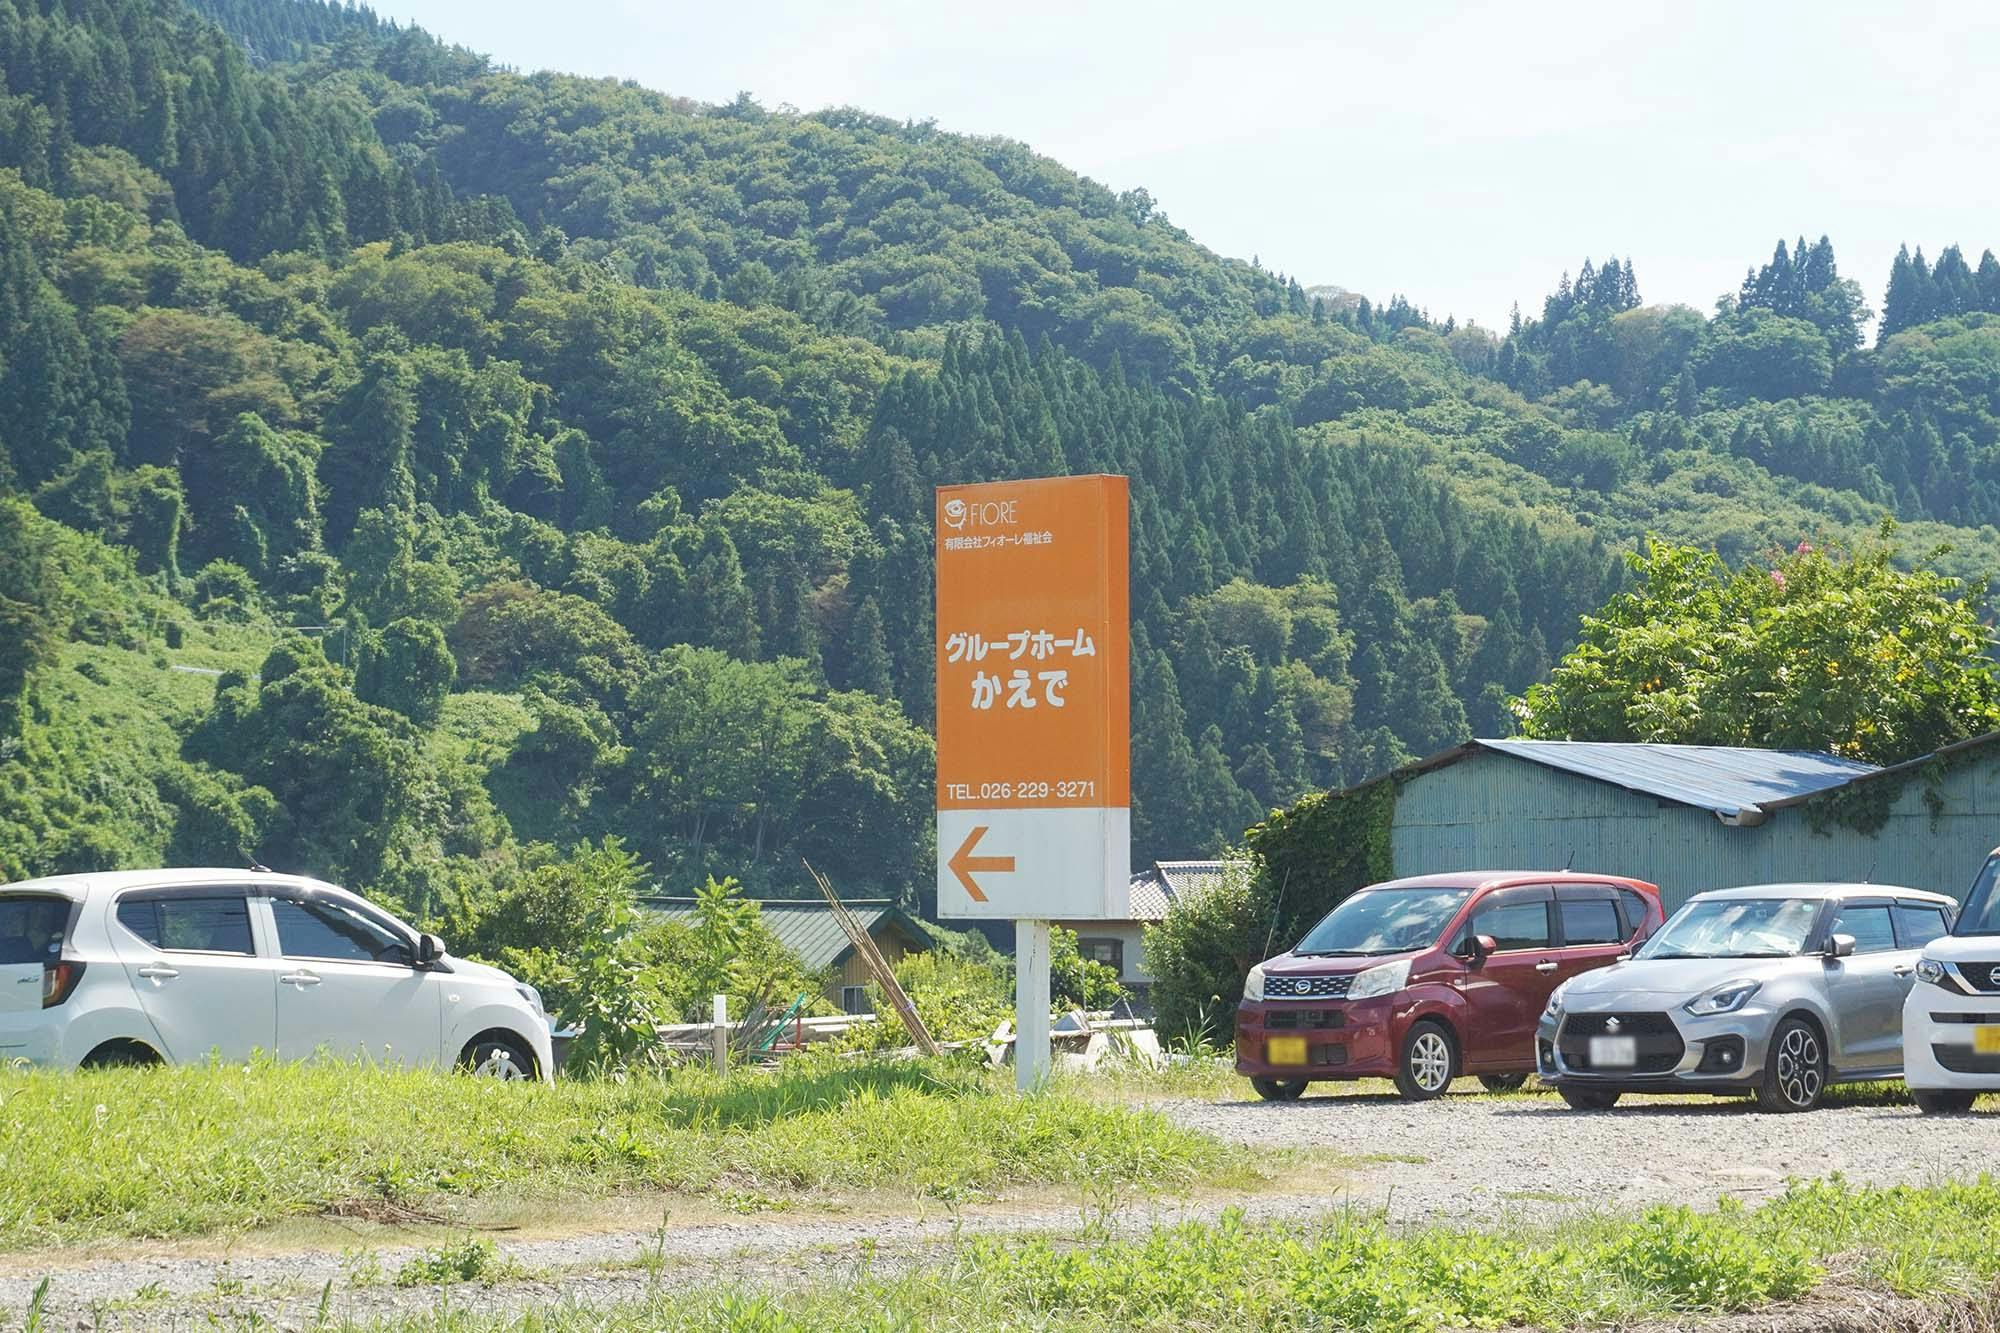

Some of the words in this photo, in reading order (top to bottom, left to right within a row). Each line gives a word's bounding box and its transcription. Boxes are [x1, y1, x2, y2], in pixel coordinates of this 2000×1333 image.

[970, 500, 1018, 527] FIORE
[944, 530, 1053, 551] 有限会社フィオーレ福祉会
[945, 628, 1096, 663] グループホーム
[971, 669, 1068, 709] かえで
